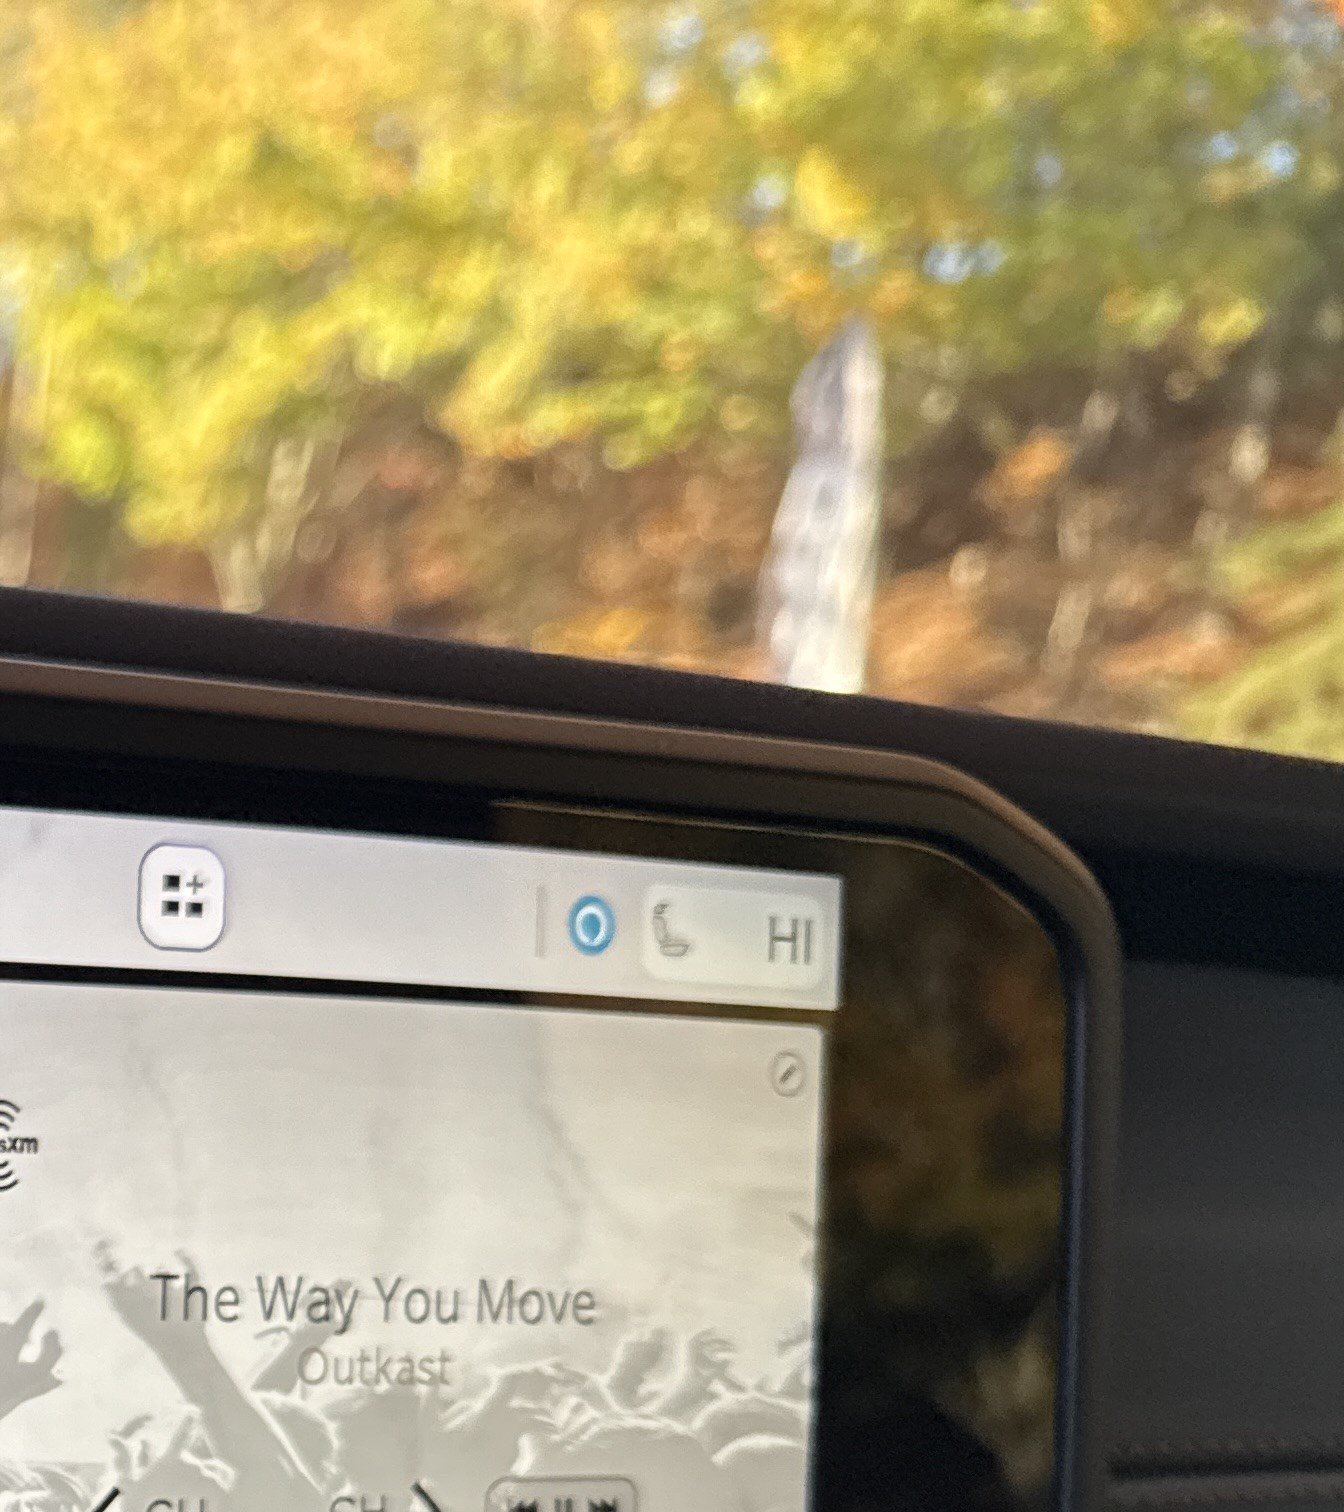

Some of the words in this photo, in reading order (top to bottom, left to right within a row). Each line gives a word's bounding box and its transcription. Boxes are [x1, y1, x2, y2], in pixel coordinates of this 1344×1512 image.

[768, 914, 813, 965] HI
[150, 1273, 240, 1323] The
[255, 1275, 359, 1334] Way
[373, 1276, 459, 1324] You
[475, 1278, 597, 1326] Move
[297, 1344, 453, 1389] Outkast
